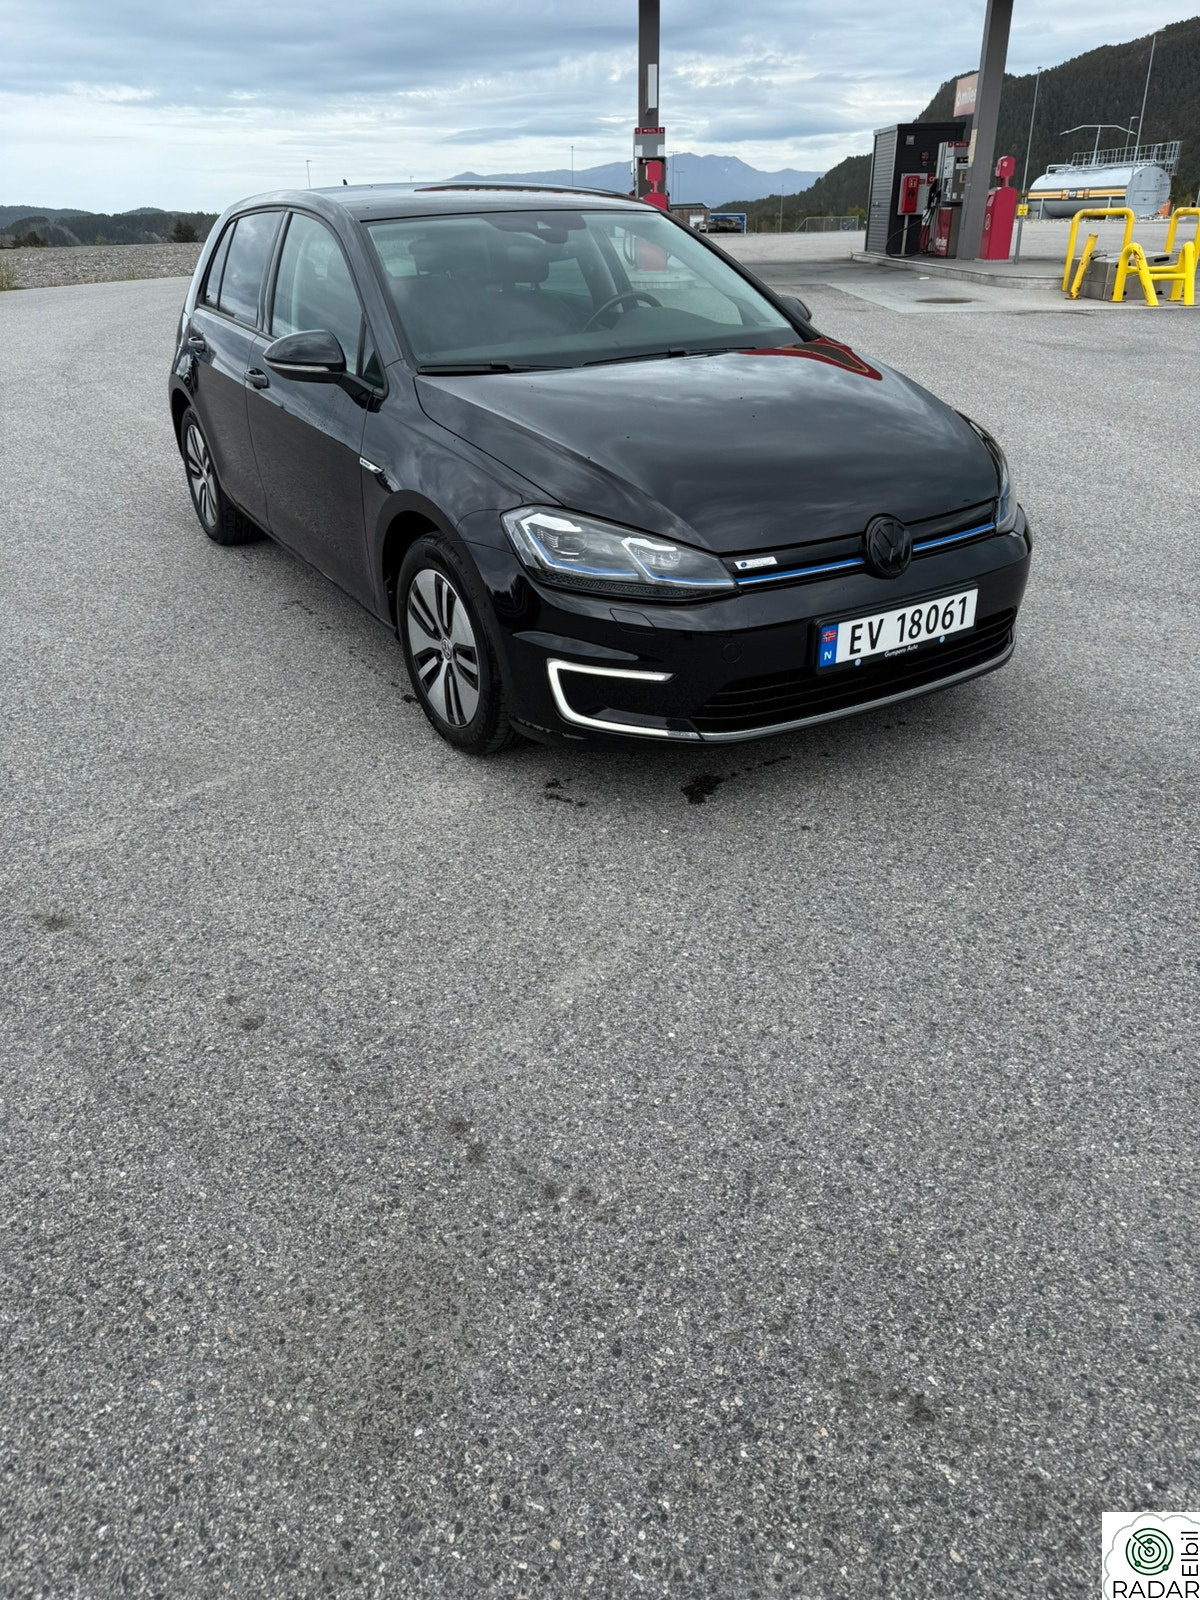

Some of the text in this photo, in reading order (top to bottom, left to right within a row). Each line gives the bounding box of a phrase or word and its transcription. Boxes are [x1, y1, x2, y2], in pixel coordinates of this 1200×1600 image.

[850, 596, 967, 655] EV 18061
[824, 650, 832, 660] N
